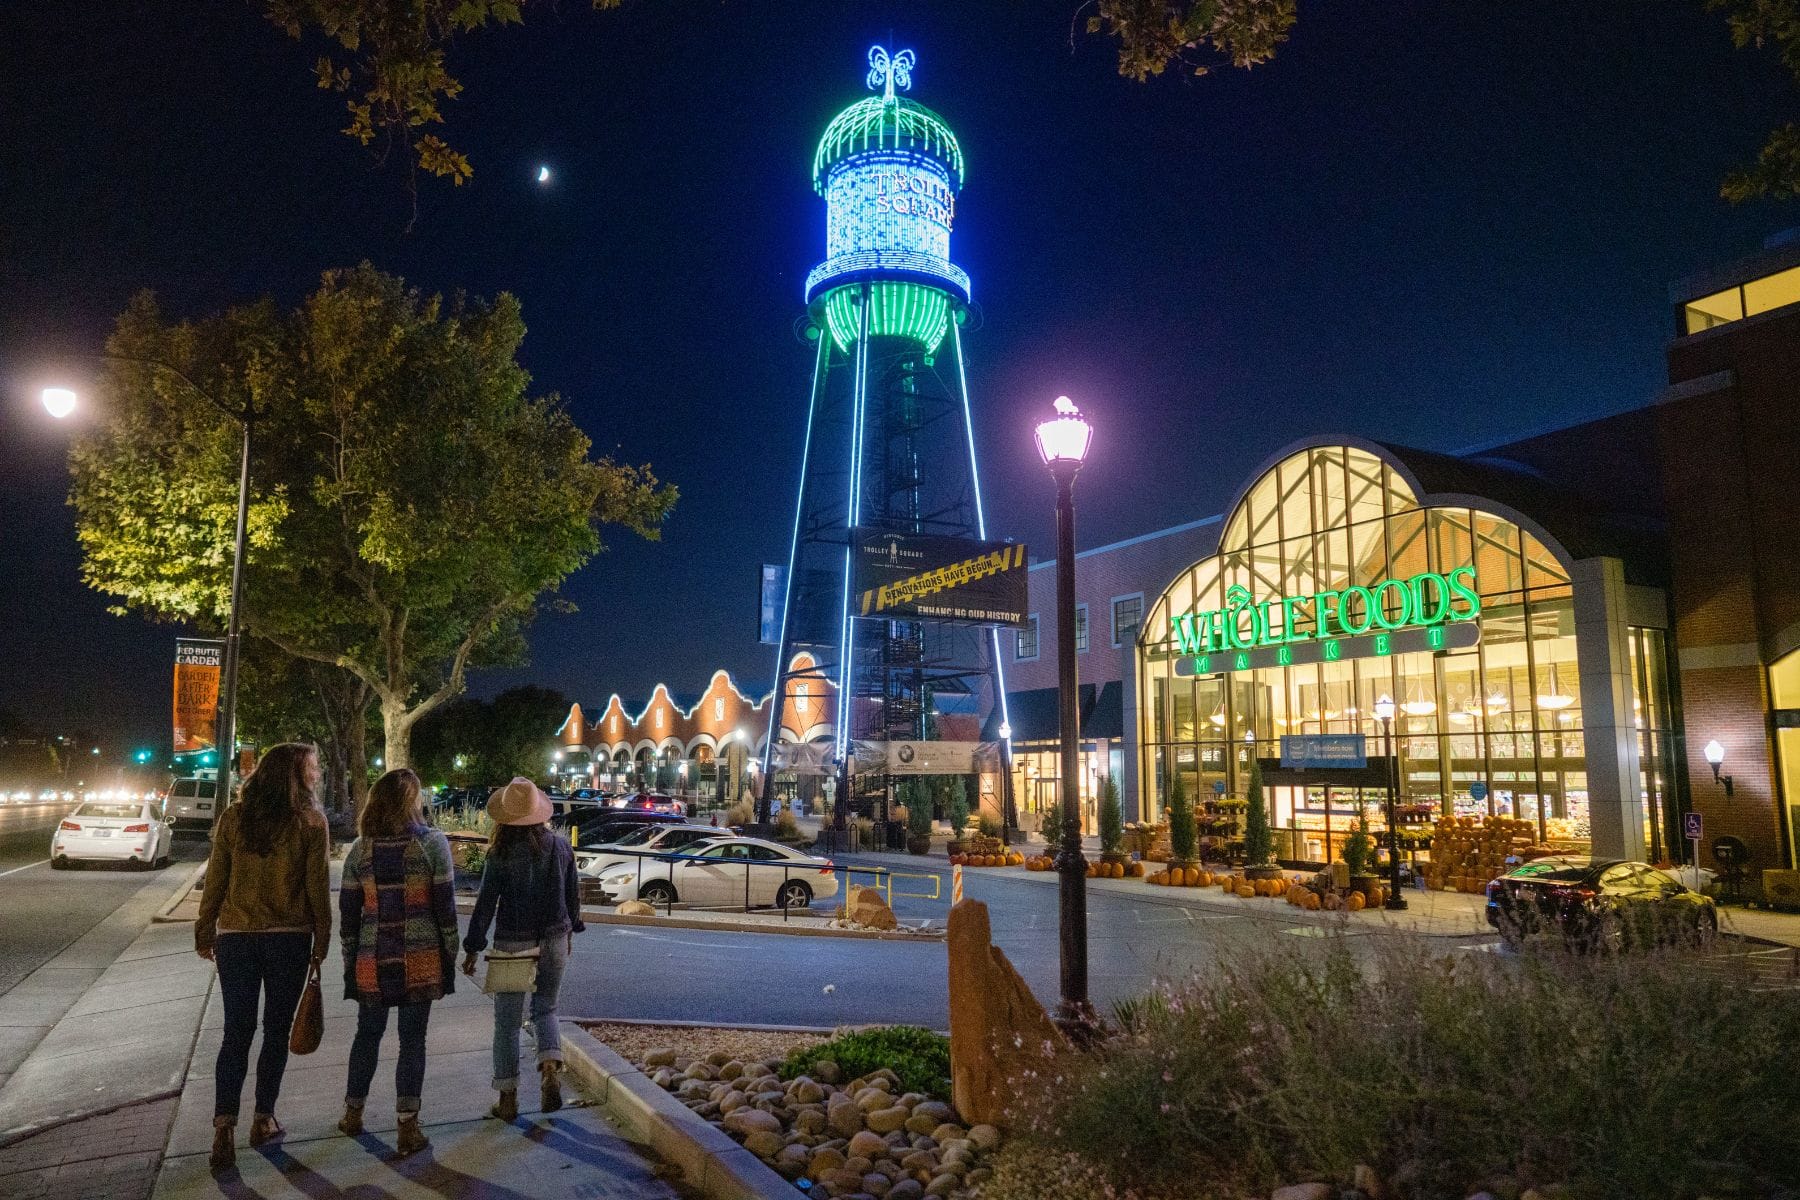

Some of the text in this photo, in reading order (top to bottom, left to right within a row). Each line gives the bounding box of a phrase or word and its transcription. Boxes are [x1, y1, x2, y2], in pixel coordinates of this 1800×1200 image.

[877, 196, 954, 233] SQUARE
[863, 546, 889, 555] TROLLEY
[885, 575, 943, 601] RENOVATIONS
[944, 571, 966, 582] HAVE
[1171, 566, 1481, 656] WHOLE FOODS
[986, 611, 1021, 623] HISTORY
[177, 647, 220, 656] RED BUTTE
[1195, 627, 1445, 674] MARKET
[176, 656, 220, 665] GARDEN
[178, 671, 216, 682] GARDEN
[181, 682, 210, 693] AFTER
